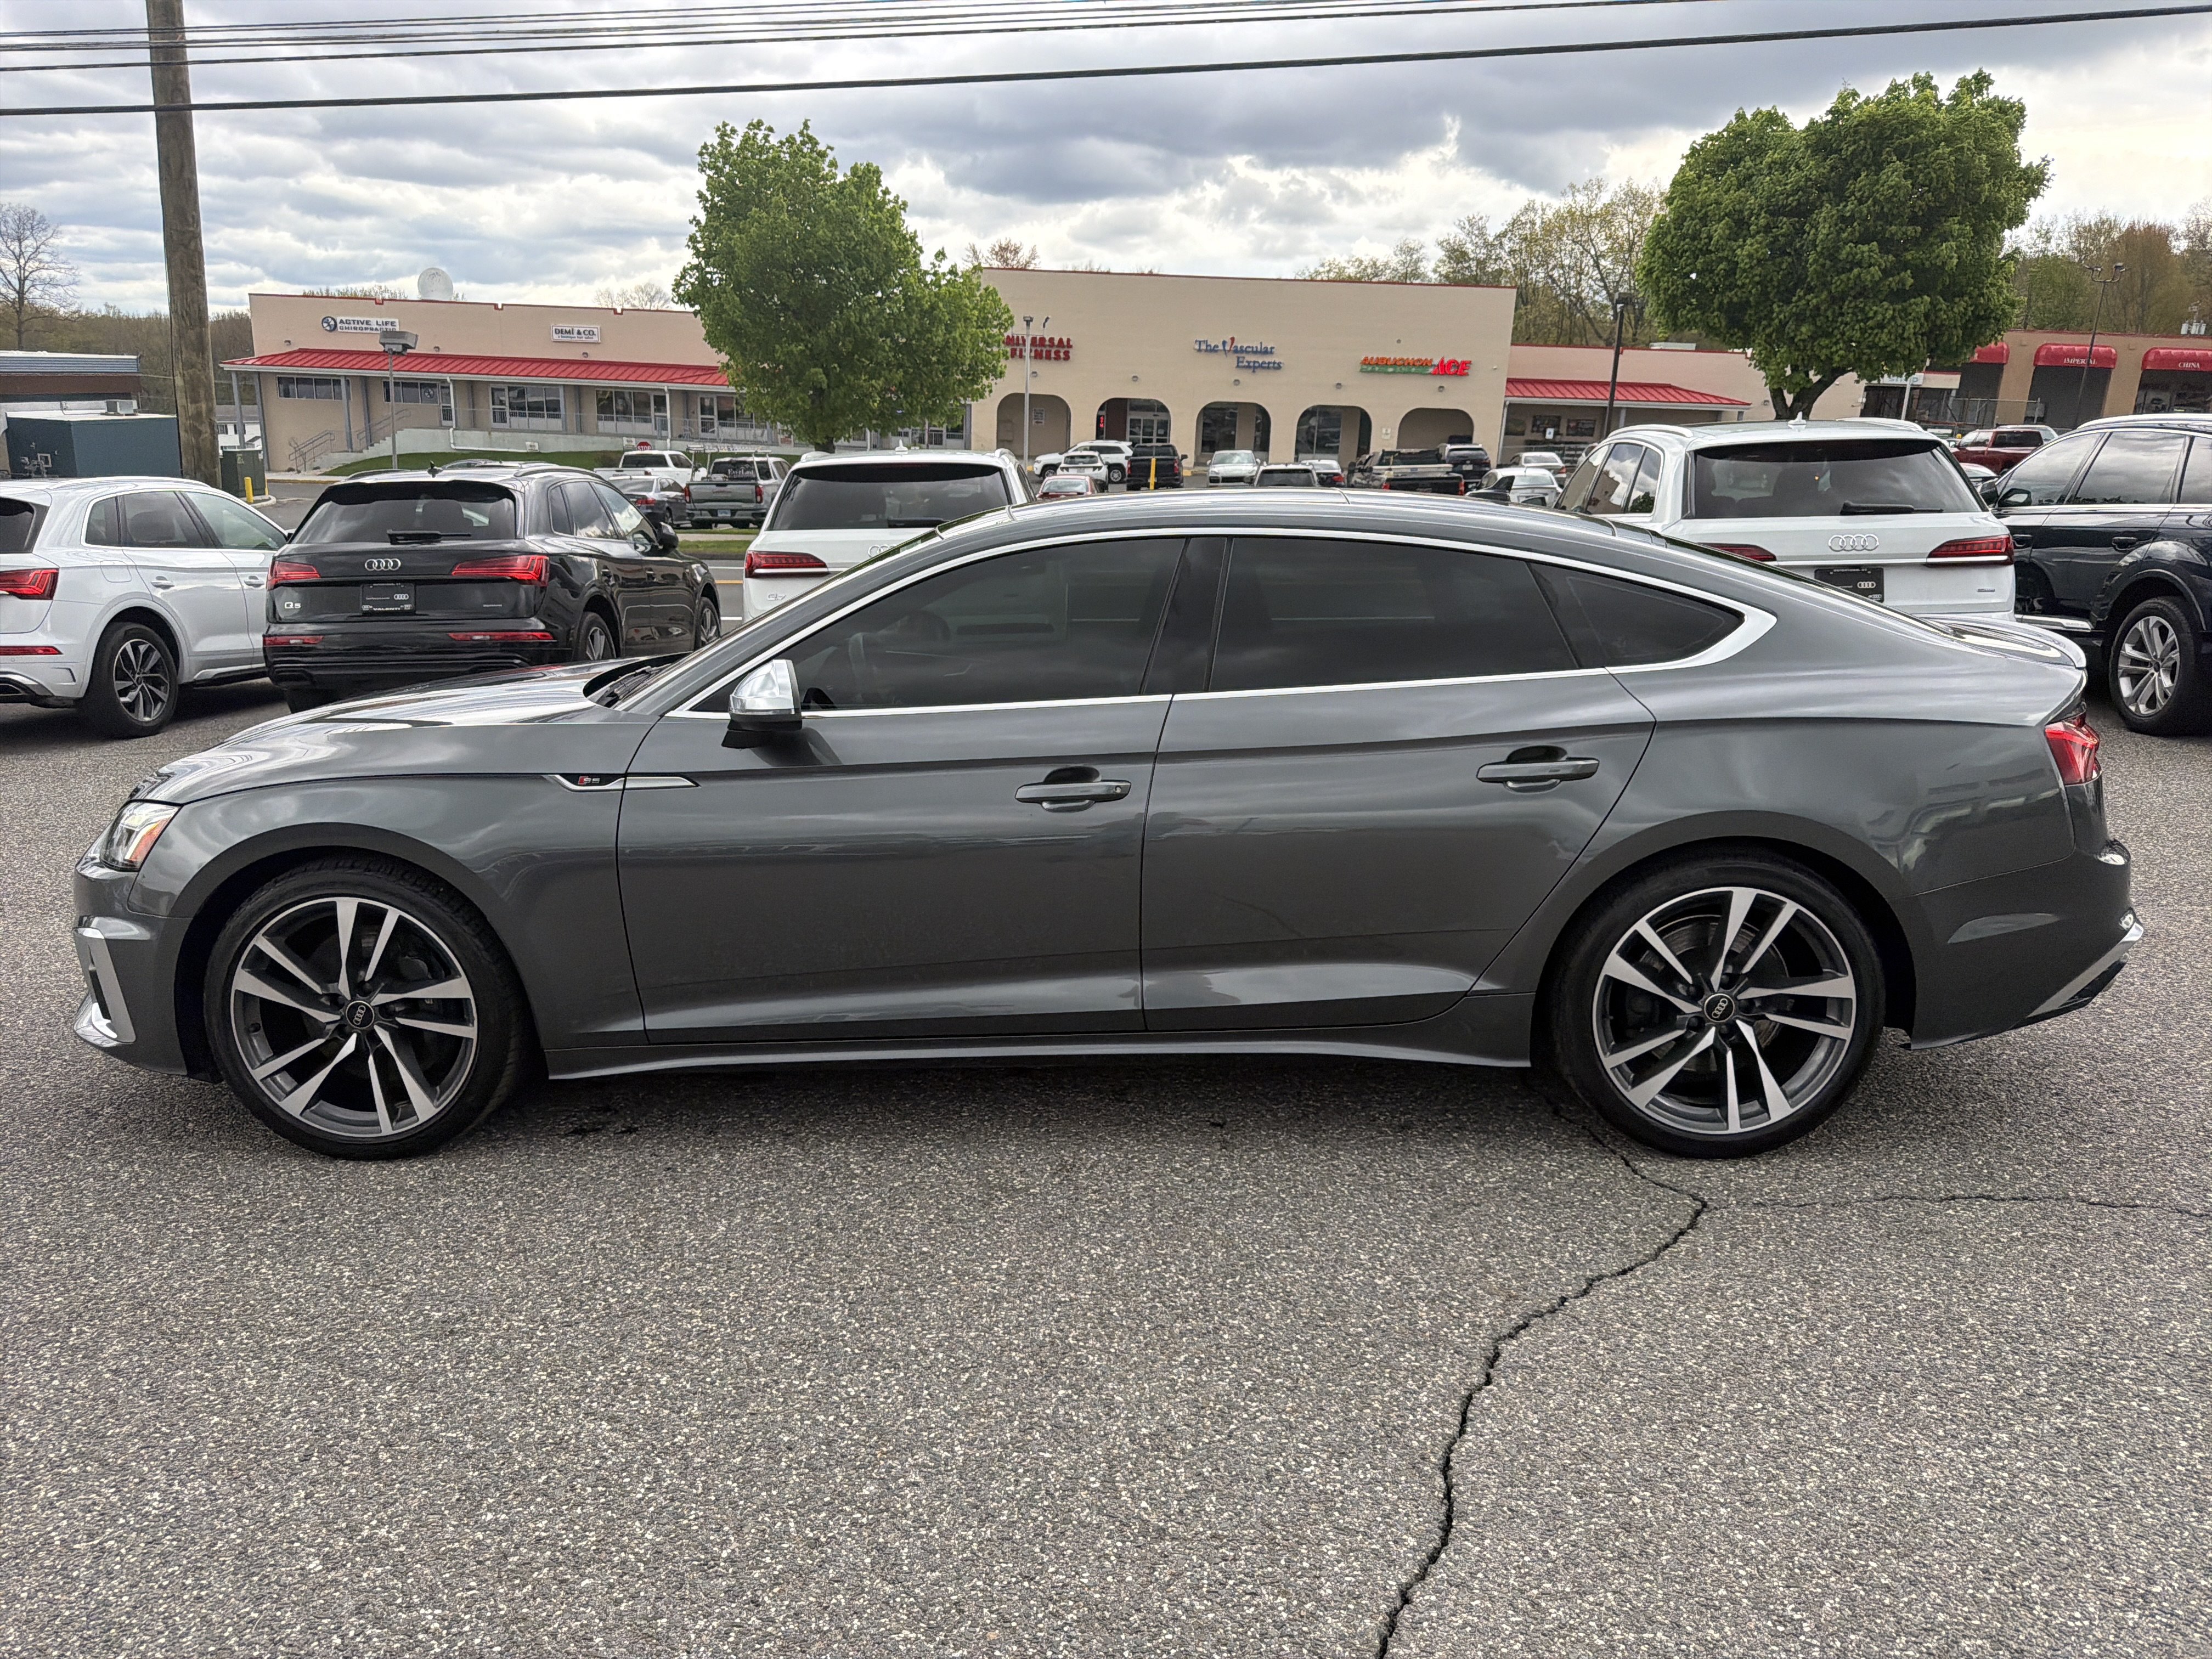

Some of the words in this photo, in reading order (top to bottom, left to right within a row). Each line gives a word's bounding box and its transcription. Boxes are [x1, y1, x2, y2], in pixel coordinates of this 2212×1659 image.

[1003, 335, 1073, 348] NIVERSAL
[1195, 339, 1218, 352] The
[1222, 336, 1275, 357] Vascular
[1235, 356, 1282, 373] Experts
[1360, 356, 1433, 366] AUBUCHON
[1431, 357, 1472, 375] ACE
